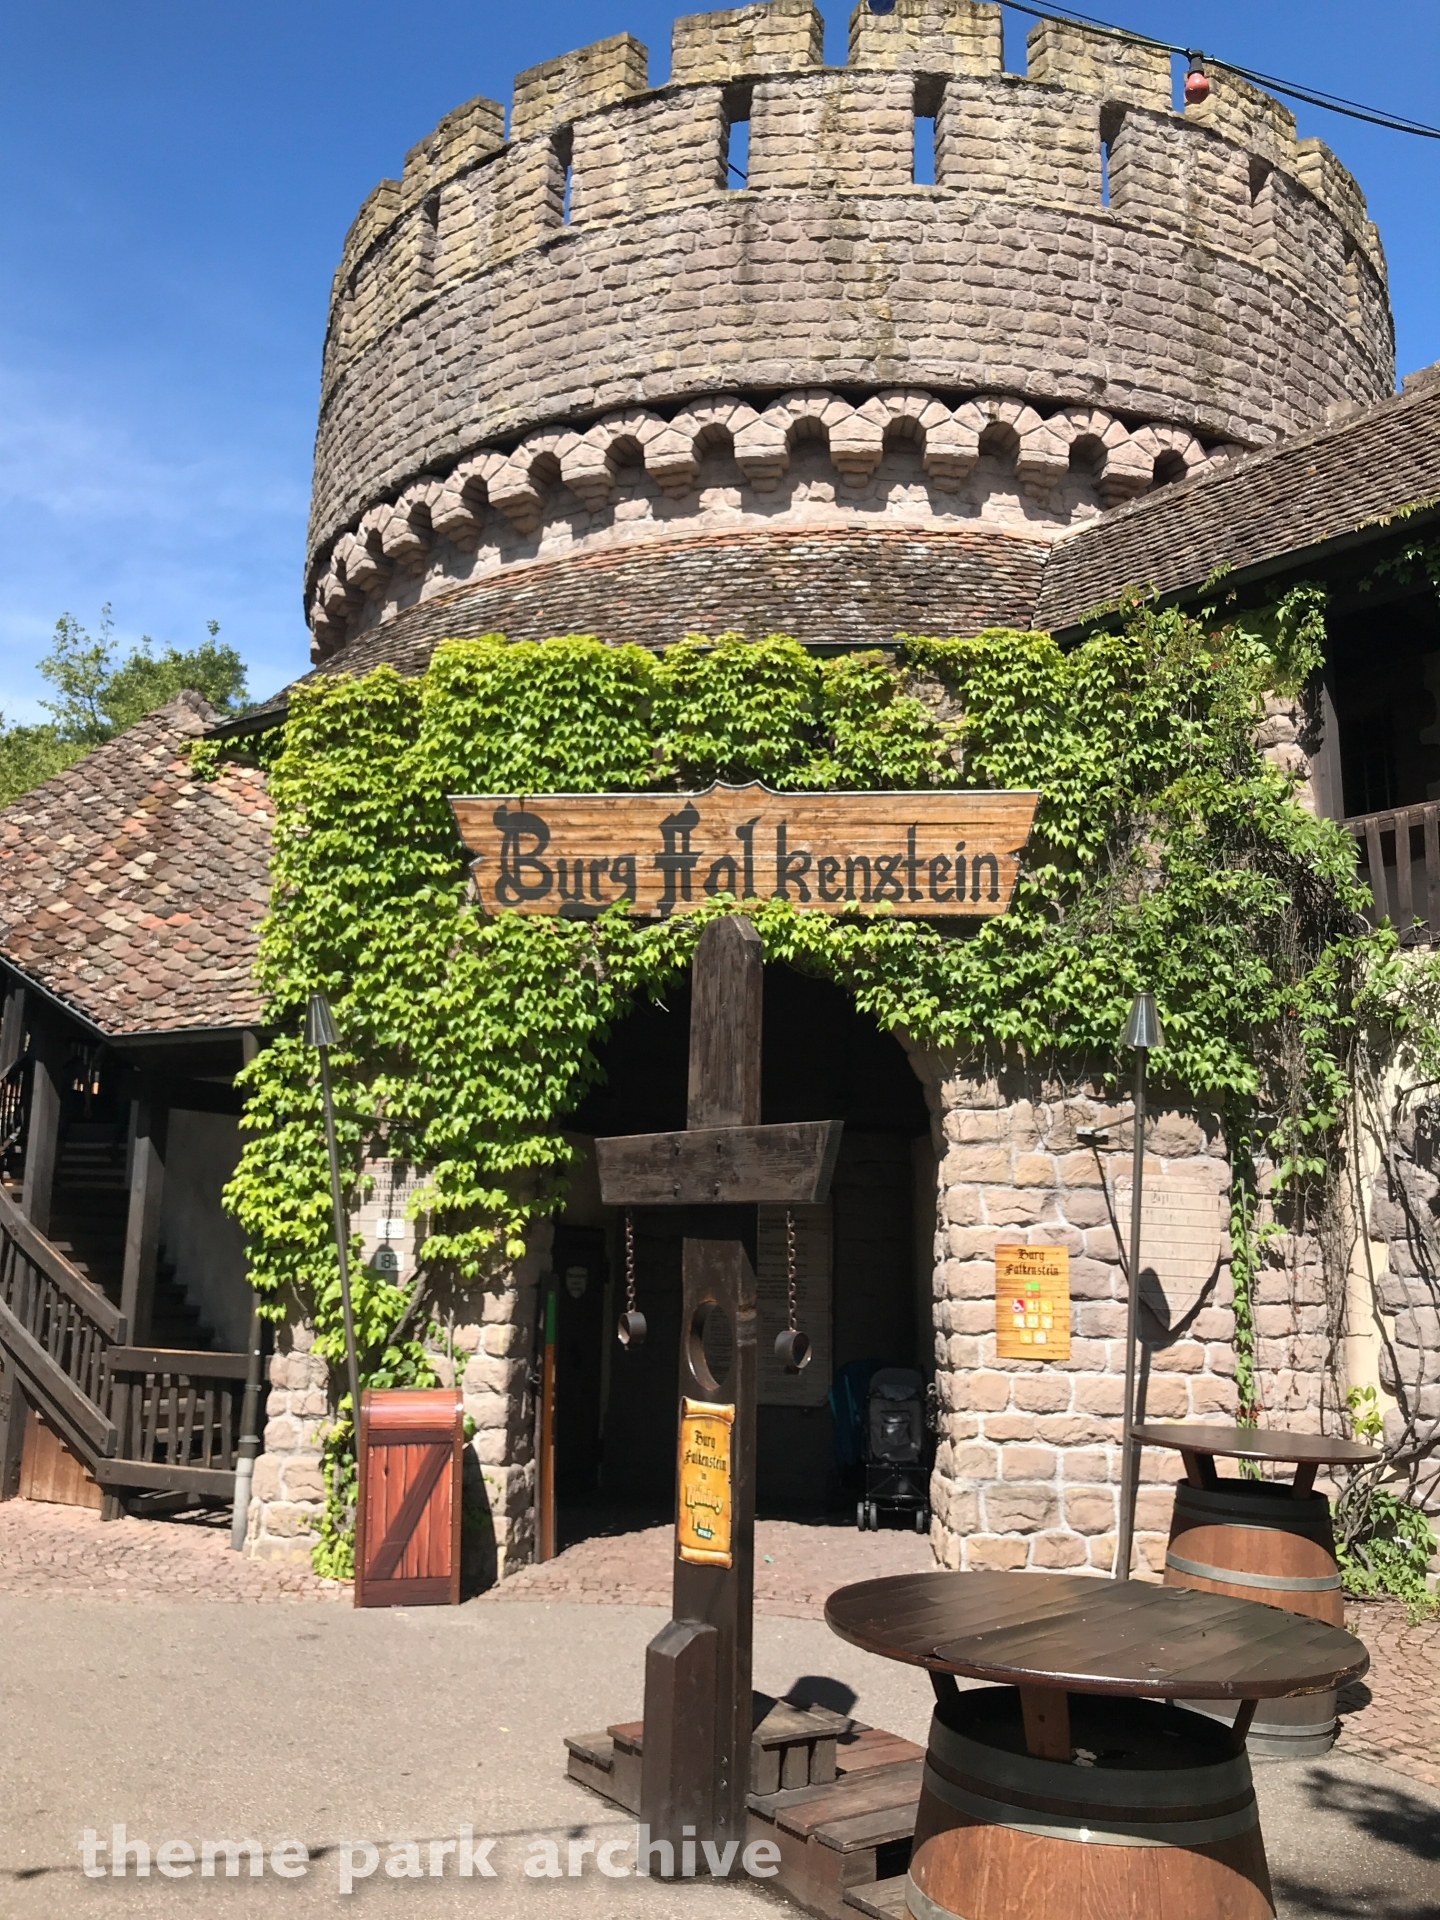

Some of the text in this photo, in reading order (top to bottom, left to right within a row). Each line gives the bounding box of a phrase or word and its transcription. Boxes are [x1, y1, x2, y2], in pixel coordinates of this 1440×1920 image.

[493, 800, 1001, 917] Burg Falkenstein
[1017, 1248, 1045, 1263] Burg
[1004, 1263, 1059, 1276] Falkenstein
[694, 1430, 716, 1451] Burg
[684, 1450, 727, 1472] Falkenstein
[685, 1483, 724, 1514] Holiday
[691, 1508, 716, 1535] Park
